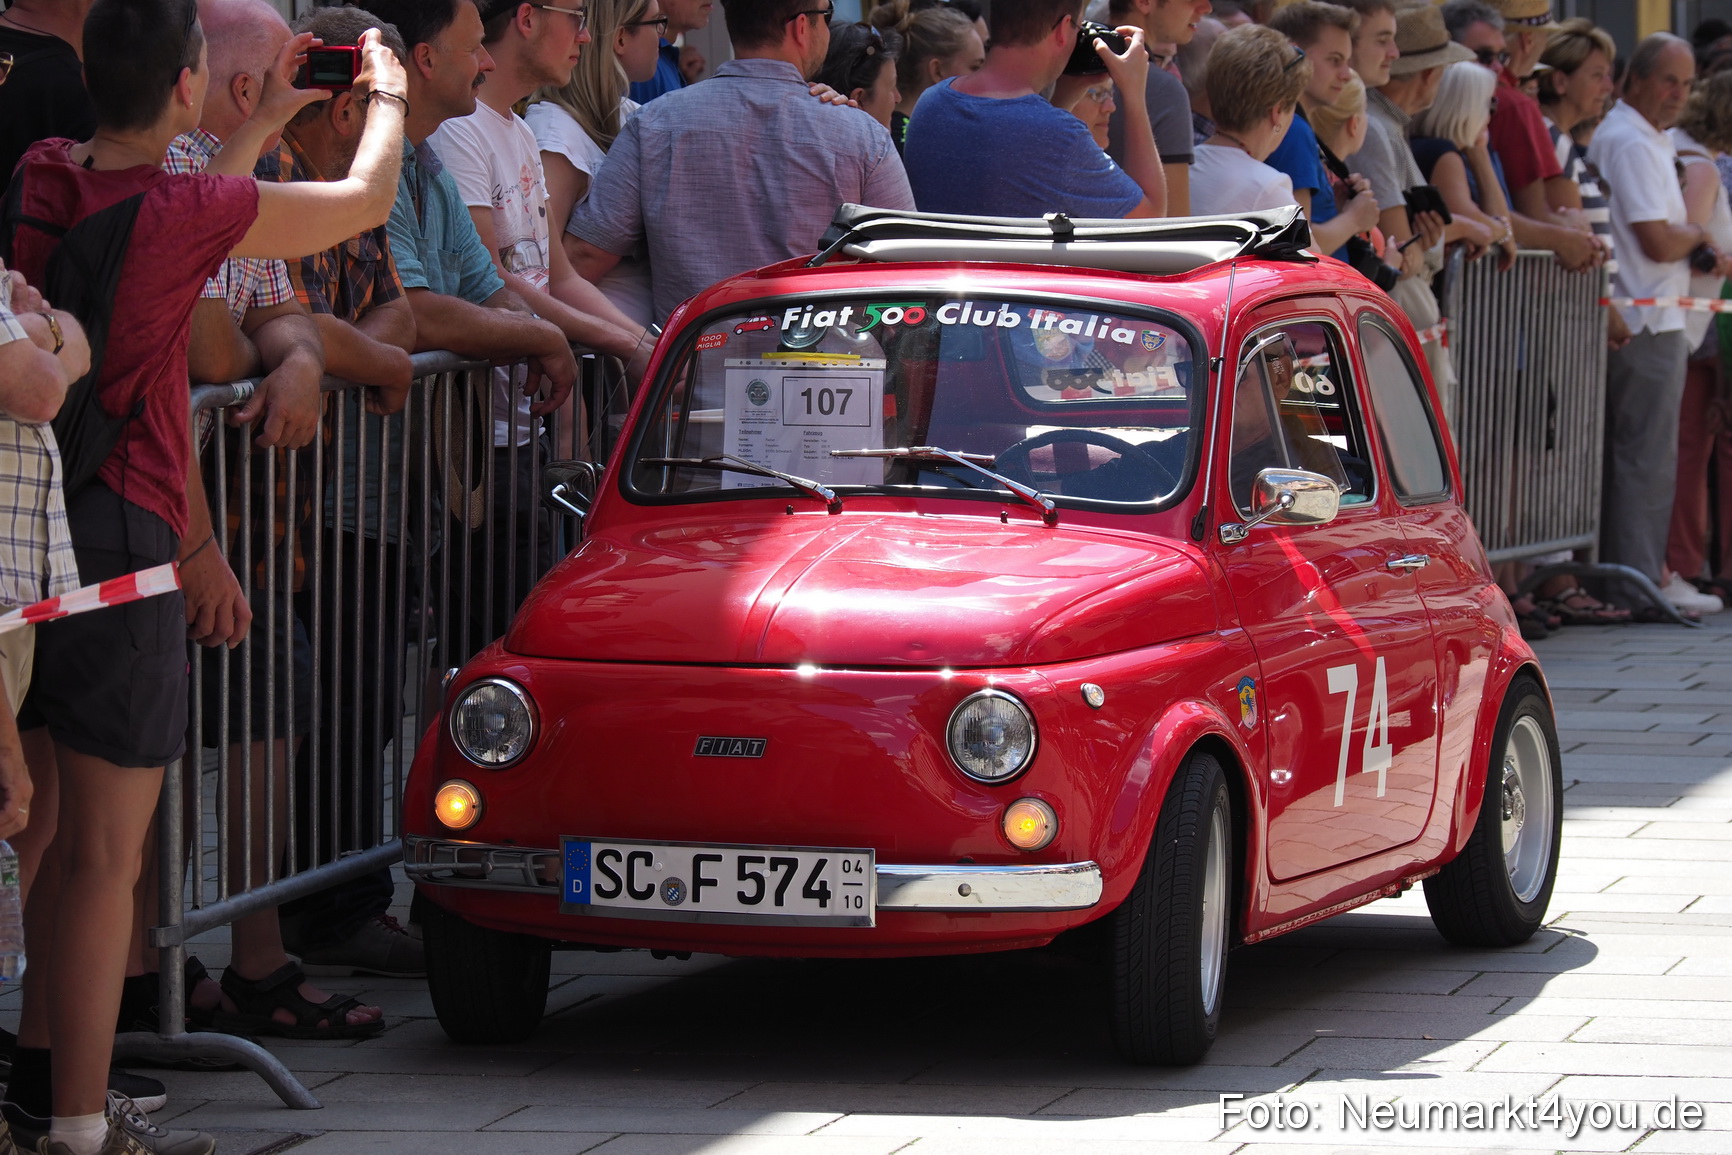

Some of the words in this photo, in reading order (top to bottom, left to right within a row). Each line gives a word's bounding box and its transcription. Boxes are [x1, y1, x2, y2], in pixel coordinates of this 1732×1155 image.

[781, 304, 854, 331] Fiat
[854, 302, 927, 334] 500
[936, 301, 1021, 328] Club
[1029, 308, 1136, 345] Italia
[696, 341, 722, 349] MIGLIA
[701, 334, 722, 342] 1000
[801, 387, 853, 416] 107
[1326, 656, 1393, 808] 74
[698, 740, 762, 755] FIAT
[842, 859, 863, 874] 04
[594, 848, 656, 900] SC
[692, 853, 723, 903] F
[736, 855, 832, 908] 574
[572, 879, 583, 893] D
[843, 895, 863, 909] 10
